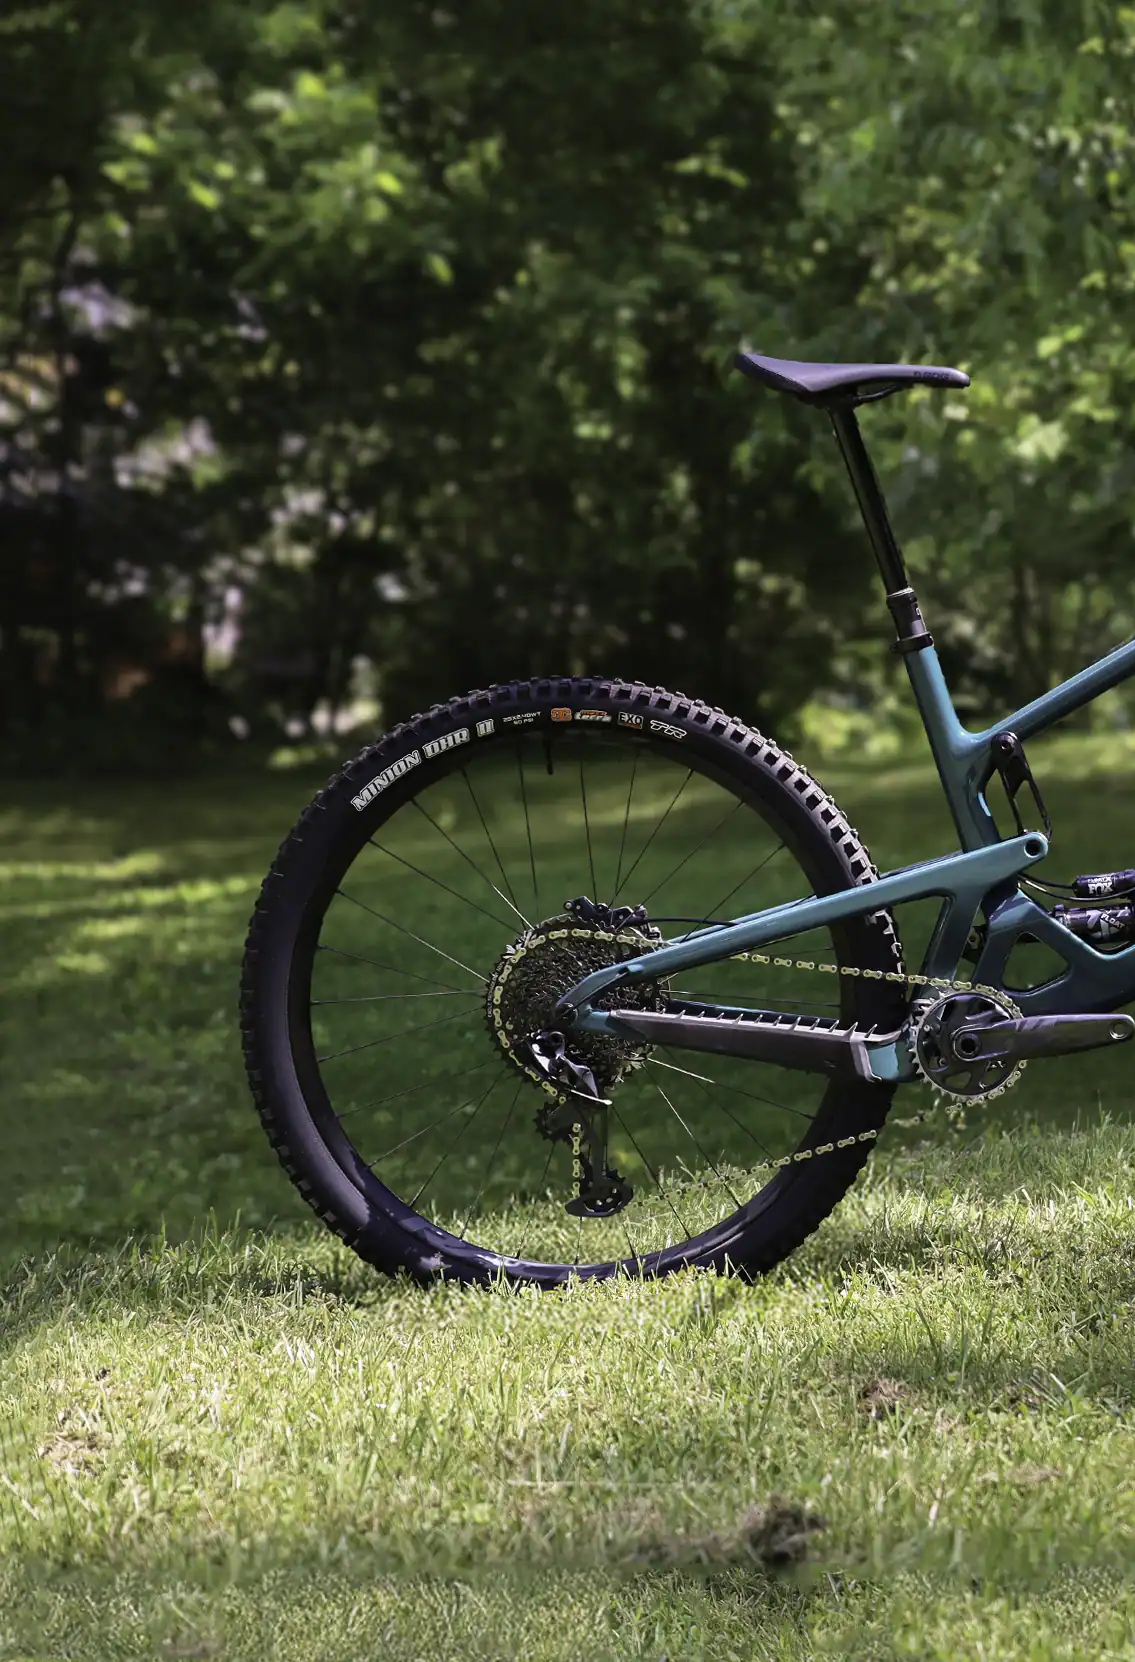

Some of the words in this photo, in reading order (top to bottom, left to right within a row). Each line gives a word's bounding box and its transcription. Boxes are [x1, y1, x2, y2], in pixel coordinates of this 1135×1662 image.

[619, 712, 642, 726] EXO
[650, 719, 687, 739] TR
[351, 750, 422, 811] MINION
[423, 728, 470, 759] DHR
[476, 718, 495, 737] II
[1088, 882, 1113, 895] FOX
[1100, 913, 1125, 929] FLOAT
